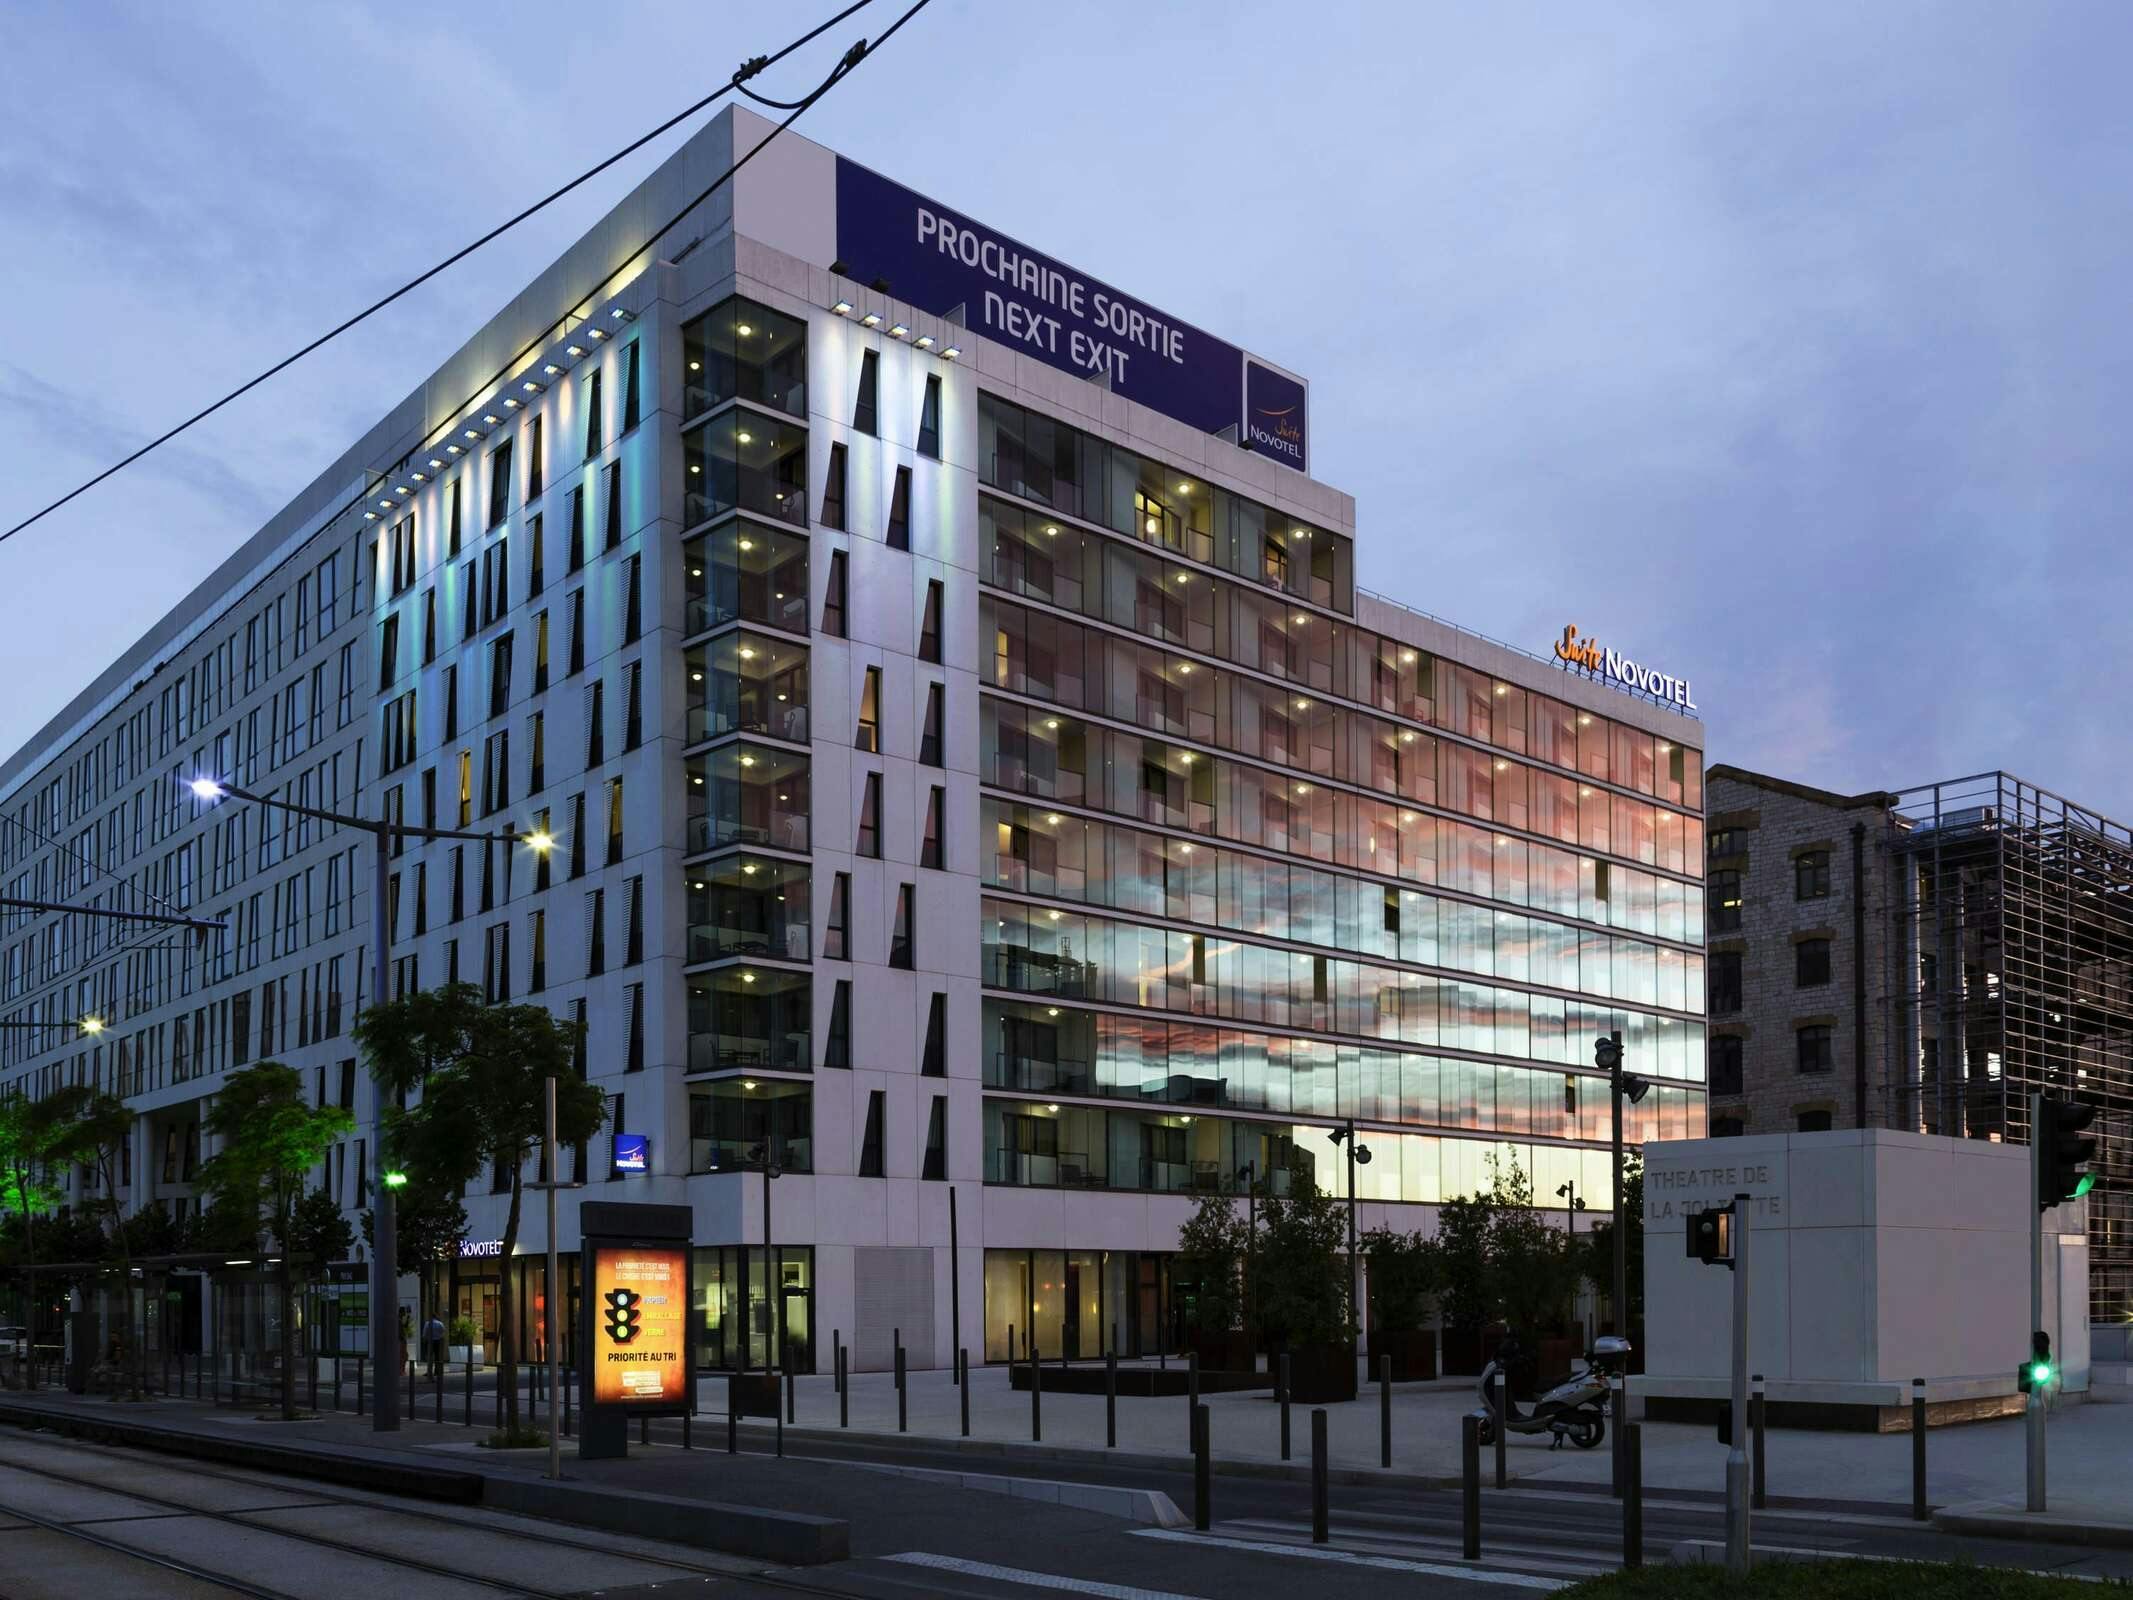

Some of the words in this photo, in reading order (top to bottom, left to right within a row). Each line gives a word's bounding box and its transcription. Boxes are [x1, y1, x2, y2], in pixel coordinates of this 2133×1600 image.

[918, 207, 1085, 318] PROCHAINE
[1094, 293, 1184, 364] SORTIE
[985, 290, 1062, 353] NEXT
[1070, 330, 1129, 384] EXIT
[1250, 424, 1302, 458] NOVOTEL
[1604, 647, 1697, 710] NOVOTEL
[1650, 1168, 1737, 1189] THEATRE
[1744, 1166, 1767, 1184] DE
[1651, 1201, 1676, 1219] LA
[460, 1240, 501, 1256] NOVOTEL
[608, 1351, 648, 1362] PRIORITÉ
[650, 1353, 662, 1361] AU
[664, 1352, 677, 1361] TRI
